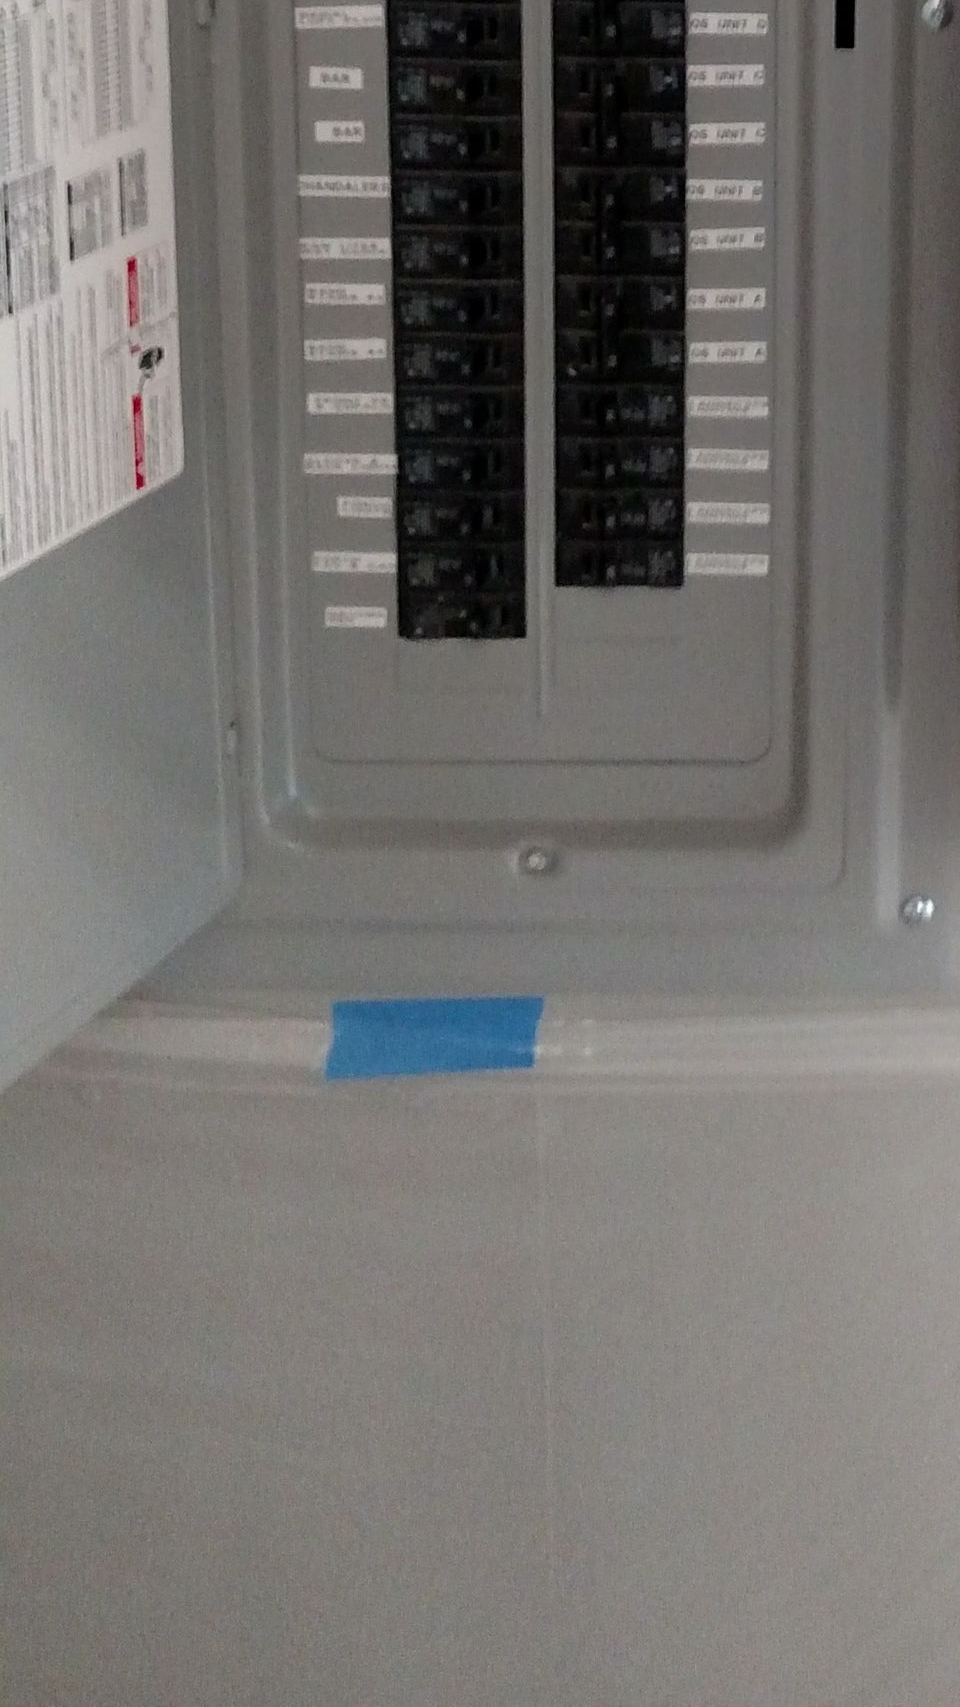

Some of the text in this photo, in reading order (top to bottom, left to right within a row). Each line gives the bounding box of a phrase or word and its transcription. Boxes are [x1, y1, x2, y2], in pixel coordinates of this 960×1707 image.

[717, 18, 747, 29] UNIT
[715, 70, 743, 81] UNIT
[717, 128, 745, 139] UNIT
